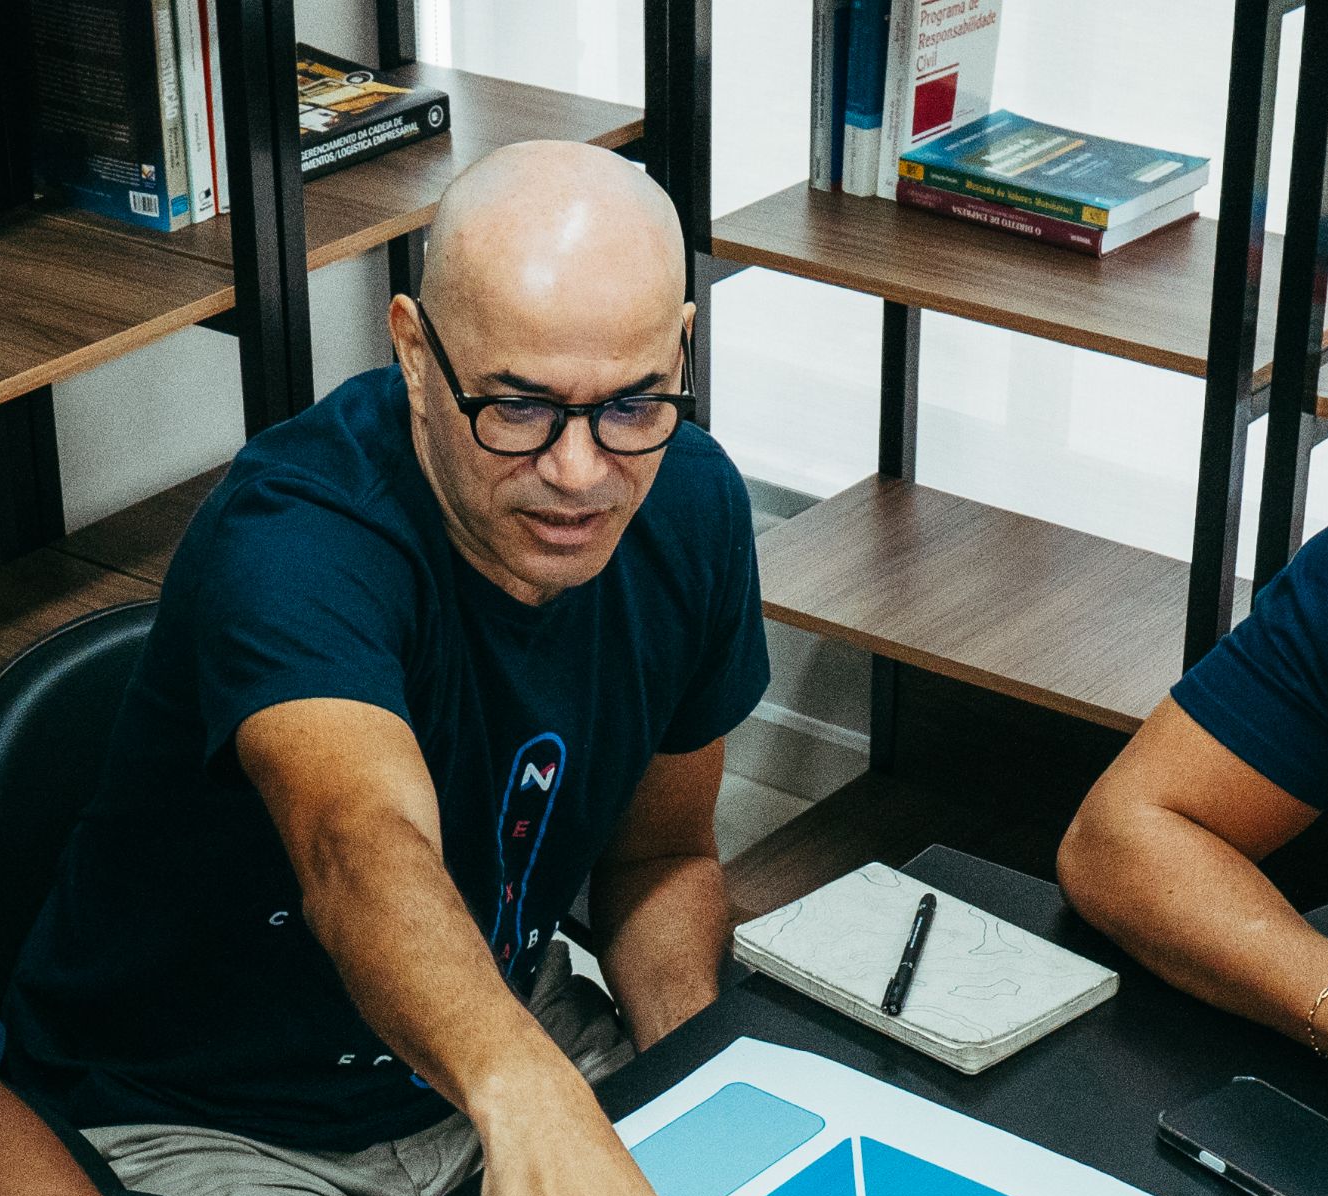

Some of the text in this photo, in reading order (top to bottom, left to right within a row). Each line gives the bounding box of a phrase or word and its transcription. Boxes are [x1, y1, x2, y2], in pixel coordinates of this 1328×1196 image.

[920, 1, 965, 27] Programa
[918, 11, 997, 49] Responsabilidade
[916, 51, 938, 72] Civil
[301, 114, 404, 160] GERENCIAMENTO DA CADEIA DE
[372, 122, 419, 145] EMPRESARIAL
[951, 202, 989, 222] EMPRESA
[989, 214, 1001, 225] DE
[1001, 216, 1034, 235] DIREITO
